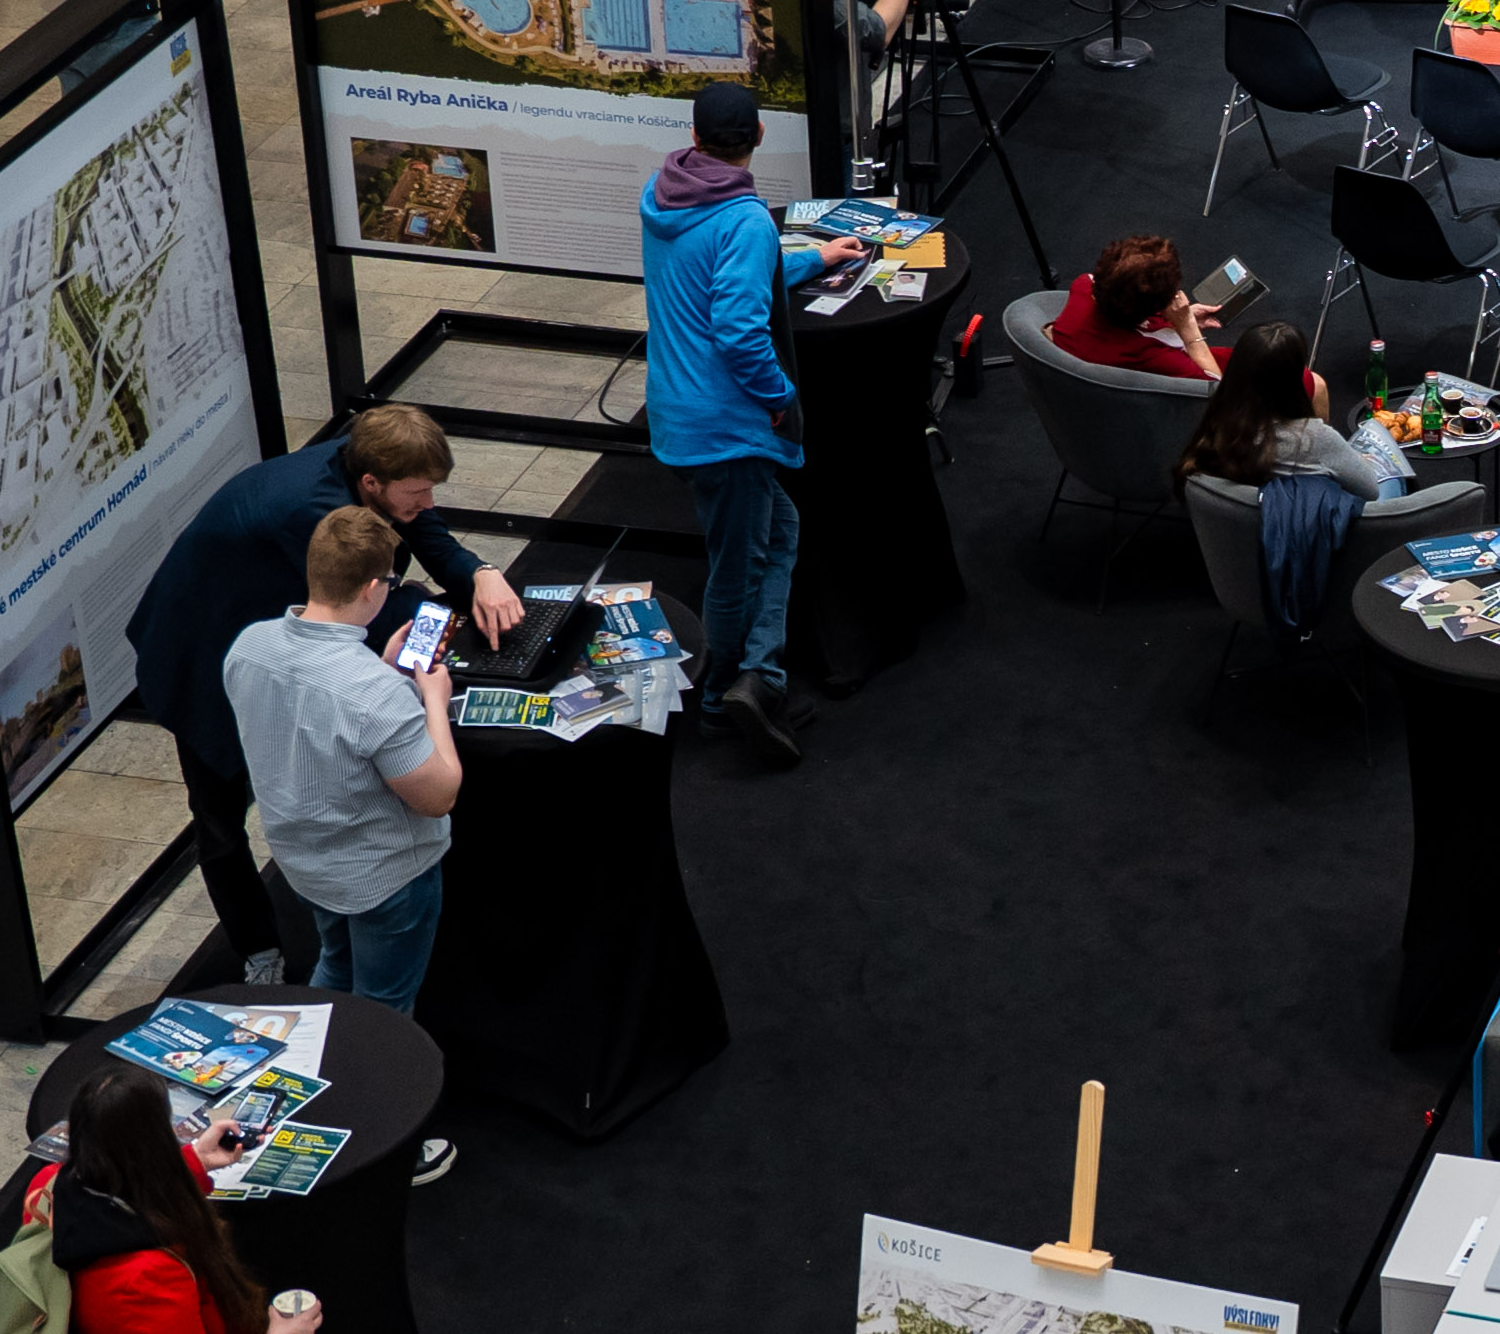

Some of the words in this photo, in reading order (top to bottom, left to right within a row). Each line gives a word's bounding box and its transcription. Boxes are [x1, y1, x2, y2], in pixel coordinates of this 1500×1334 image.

[346, 83, 392, 104] Areál
[397, 87, 441, 108] Ryba
[446, 92, 509, 113] Anička
[521, 103, 573, 122] legendu
[576, 110, 634, 125] vraciame
[8, 549, 57, 607] mestské
[58, 505, 107, 558] centrum
[107, 463, 148, 513] Hornád
[531, 586, 573, 600] NOVÉ
[891, 1238, 941, 1263] KOŠICE
